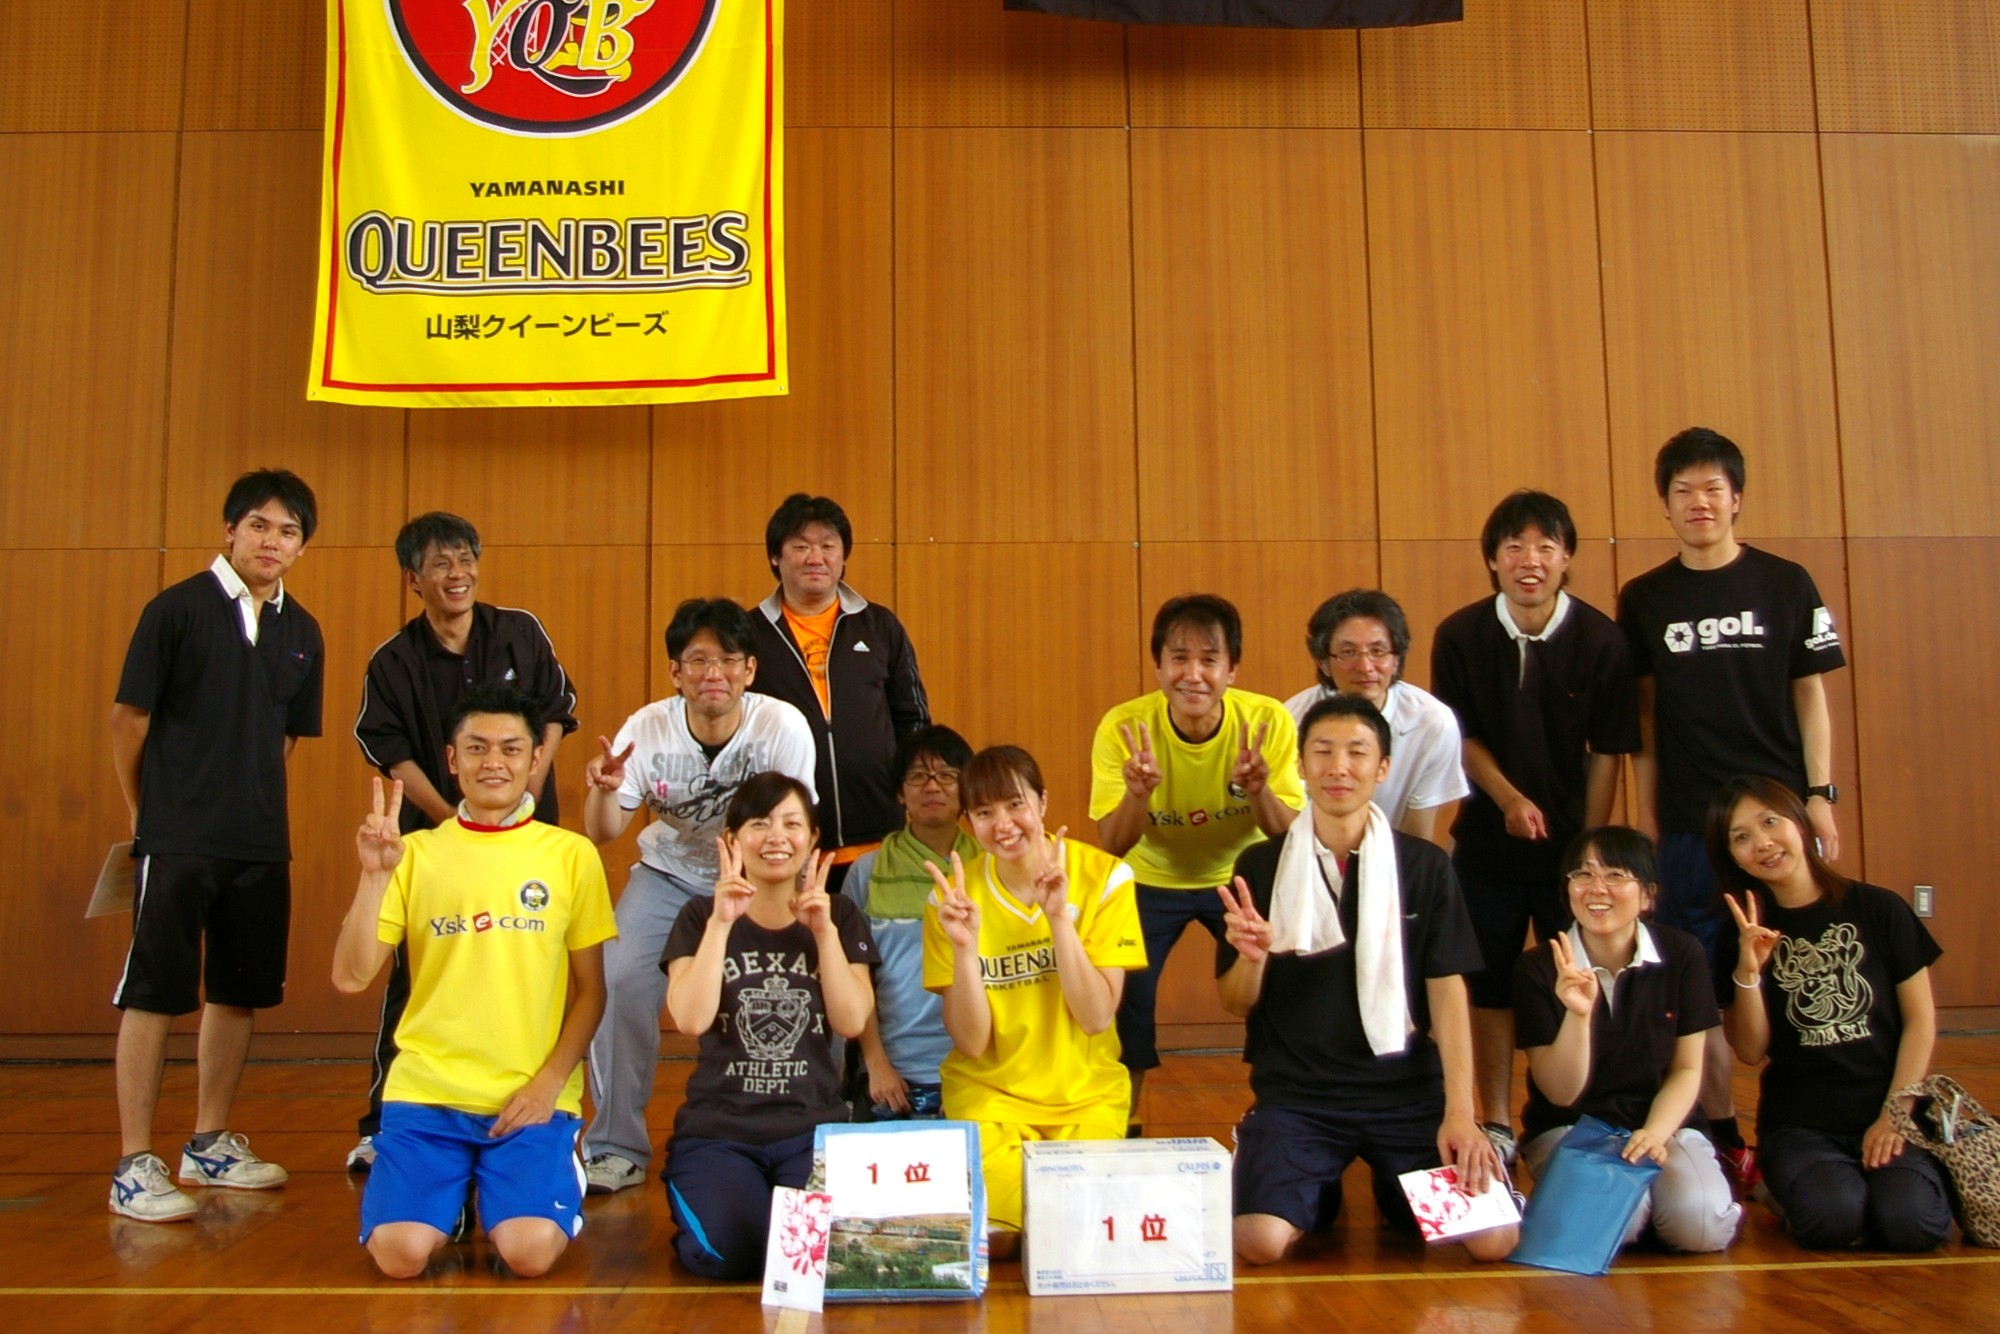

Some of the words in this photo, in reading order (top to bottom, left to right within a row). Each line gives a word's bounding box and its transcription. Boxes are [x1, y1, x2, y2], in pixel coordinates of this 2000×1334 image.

[470, 180, 626, 198] YAMANASHI
[346, 211, 752, 296] QUEENBEES
[425, 311, 669, 341] 山梨クイーンビーズ
[1148, 811, 1185, 827] Ysk
[430, 914, 468, 937] Ysk
[723, 951, 821, 983] BEXA
[725, 1061, 809, 1078] ATHLETIC
[743, 1078, 790, 1094] DEPT.
